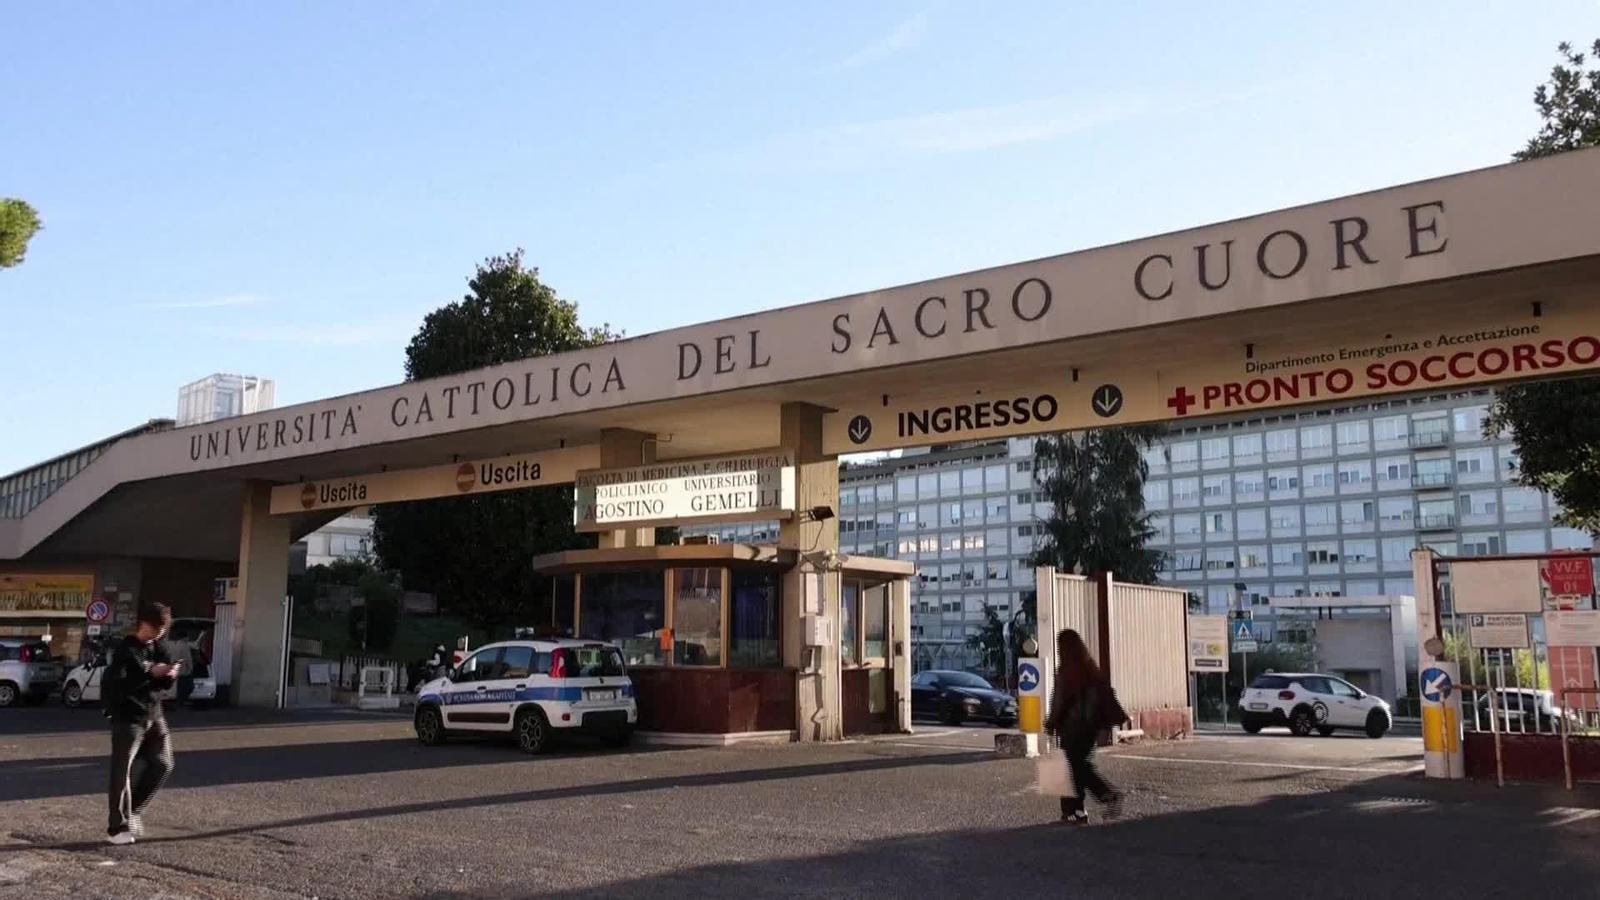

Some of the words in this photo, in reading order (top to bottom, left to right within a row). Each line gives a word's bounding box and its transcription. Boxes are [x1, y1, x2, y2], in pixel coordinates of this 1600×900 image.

[391, 357, 626, 427] CATTOLICA
[677, 330, 771, 380] DEL
[831, 278, 1052, 354] SACRO
[1134, 200, 1449, 301] CUORE
[1245, 350, 1335, 374] Dipartimento
[1339, 340, 1419, 364] Emergenza
[1423, 338, 1433, 349] e
[1437, 323, 1541, 347] Accettazione
[1203, 368, 1354, 410] PRONTO
[1366, 335, 1600, 390] SOCCORSO
[898, 394, 1058, 437] INGRESSO
[480, 463, 542, 486] Uscita
[627, 470, 638, 482] DI
[641, 464, 702, 481] MEDICINA
[703, 462, 711, 474] E
[716, 455, 790, 472] CHIRURGIA
[320, 483, 368, 503] Uscita
[594, 482, 668, 500] POLICLINICO
[684, 473, 771, 492] UNIVERSITARIO
[584, 498, 664, 520] AGOSTINO
[691, 489, 781, 512] GEMELLI
